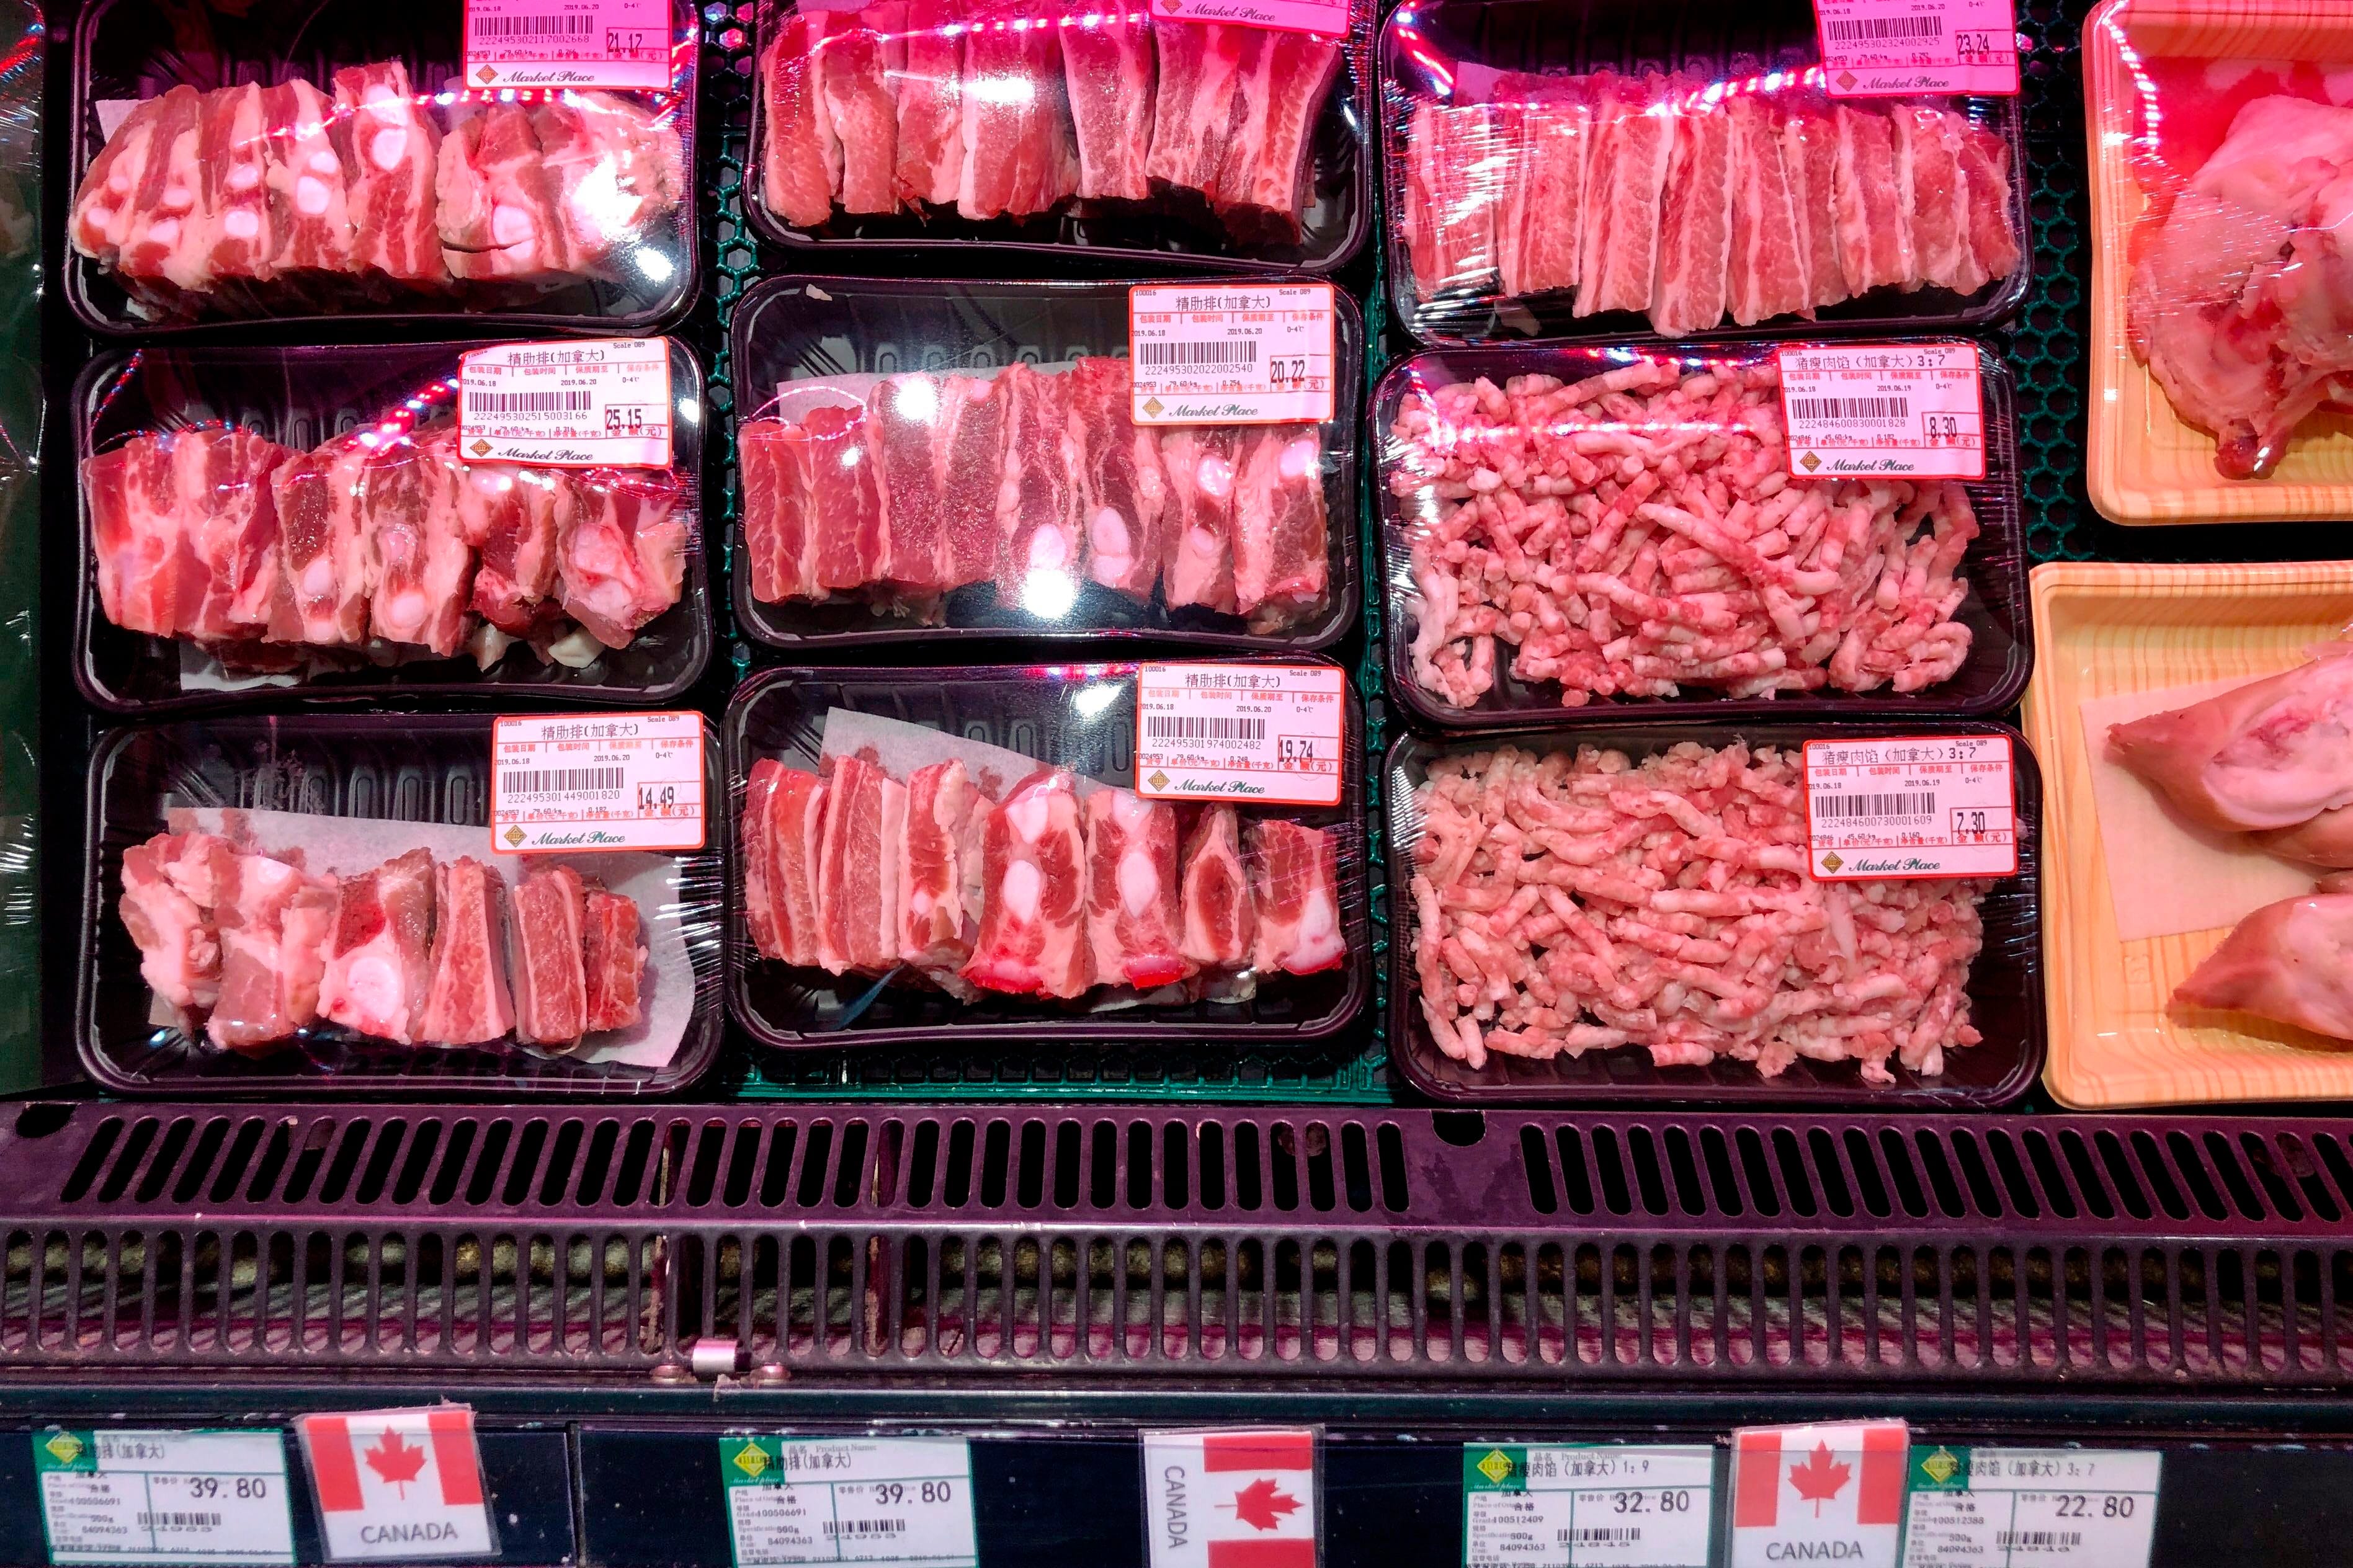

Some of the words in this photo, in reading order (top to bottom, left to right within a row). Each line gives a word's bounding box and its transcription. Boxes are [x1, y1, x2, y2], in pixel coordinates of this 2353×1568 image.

[1187, 4, 1237, 17] Market
[1239, 7, 1275, 21] Place
[480, 37, 589, 45] 222495302117002668
[608, 33, 642, 53] 21.17
[1835, 37, 1939, 50] 222495302324002925
[1957, 34, 1989, 55] 23.24
[504, 72, 555, 82] Market
[558, 71, 594, 82] Place
[1863, 77, 1911, 89] Market
[1914, 76, 1949, 88] Place
[1176, 295, 1270, 311] 精肋排(加拿大)
[507, 349, 605, 367] 精肋排(加拿大)
[470, 367, 501, 375] 包装日期
[524, 367, 556, 375] 包装时间
[1145, 364, 1252, 375] 222495302022002540
[1271, 360, 1305, 383] 20.22
[1169, 405, 1218, 416] Market
[1221, 404, 1258, 416] Place
[607, 409, 641, 430] 25.15
[1799, 419, 1906, 429] 222484600830001828
[1930, 417, 1957, 438] 8.30
[498, 447, 553, 460] Market
[556, 448, 592, 460] Place
[1827, 459, 1876, 471] Market
[1879, 459, 1914, 471] Place
[1185, 673, 1280, 688] 精肋排(加拿大)
[1201, 691, 1232, 699] 包装时间
[1251, 692, 1283, 701] 保质期至
[1302, 694, 1334, 703] 保存条件
[542, 723, 638, 740] 精肋排(加拿大)
[504, 744, 535, 752] 包装日期
[558, 742, 589, 751] 包装时间
[661, 740, 694, 748] 保存条件
[1153, 738, 1261, 749] 222495301974002482
[1279, 739, 1313, 763] 19.74
[1869, 766, 1900, 775] 包装时间
[1920, 765, 1952, 773] 保质期至
[1970, 764, 2003, 772] 保存条件
[1175, 779, 1225, 792] Market
[1228, 780, 1265, 793] Place
[507, 790, 620, 803] 222495301449001820
[639, 786, 674, 809] 14.49
[1821, 815, 1932, 828] 222484600730001609
[1957, 812, 1985, 834] 7.30
[532, 832, 584, 845] Market
[587, 831, 625, 844] Place
[1849, 858, 1900, 872] Market
[1903, 858, 1940, 870] Place
[816, 1445, 849, 1453] Product
[190, 1477, 266, 1499] 39.80
[875, 1481, 951, 1504] 39.80
[1164, 1466, 1187, 1548] CANADA
[1614, 1491, 1689, 1513] 32.80
[2055, 1495, 2134, 1518] 22.80
[757, 1508, 806, 1517] 100506691
[1494, 1515, 1543, 1523] 100512409
[361, 1521, 458, 1544] CANADA
[777, 1526, 800, 1535] 500g
[768, 1536, 813, 1545] 84094363
[1500, 1543, 1545, 1551] 84094363
[1766, 1541, 1864, 1560] CANADA
